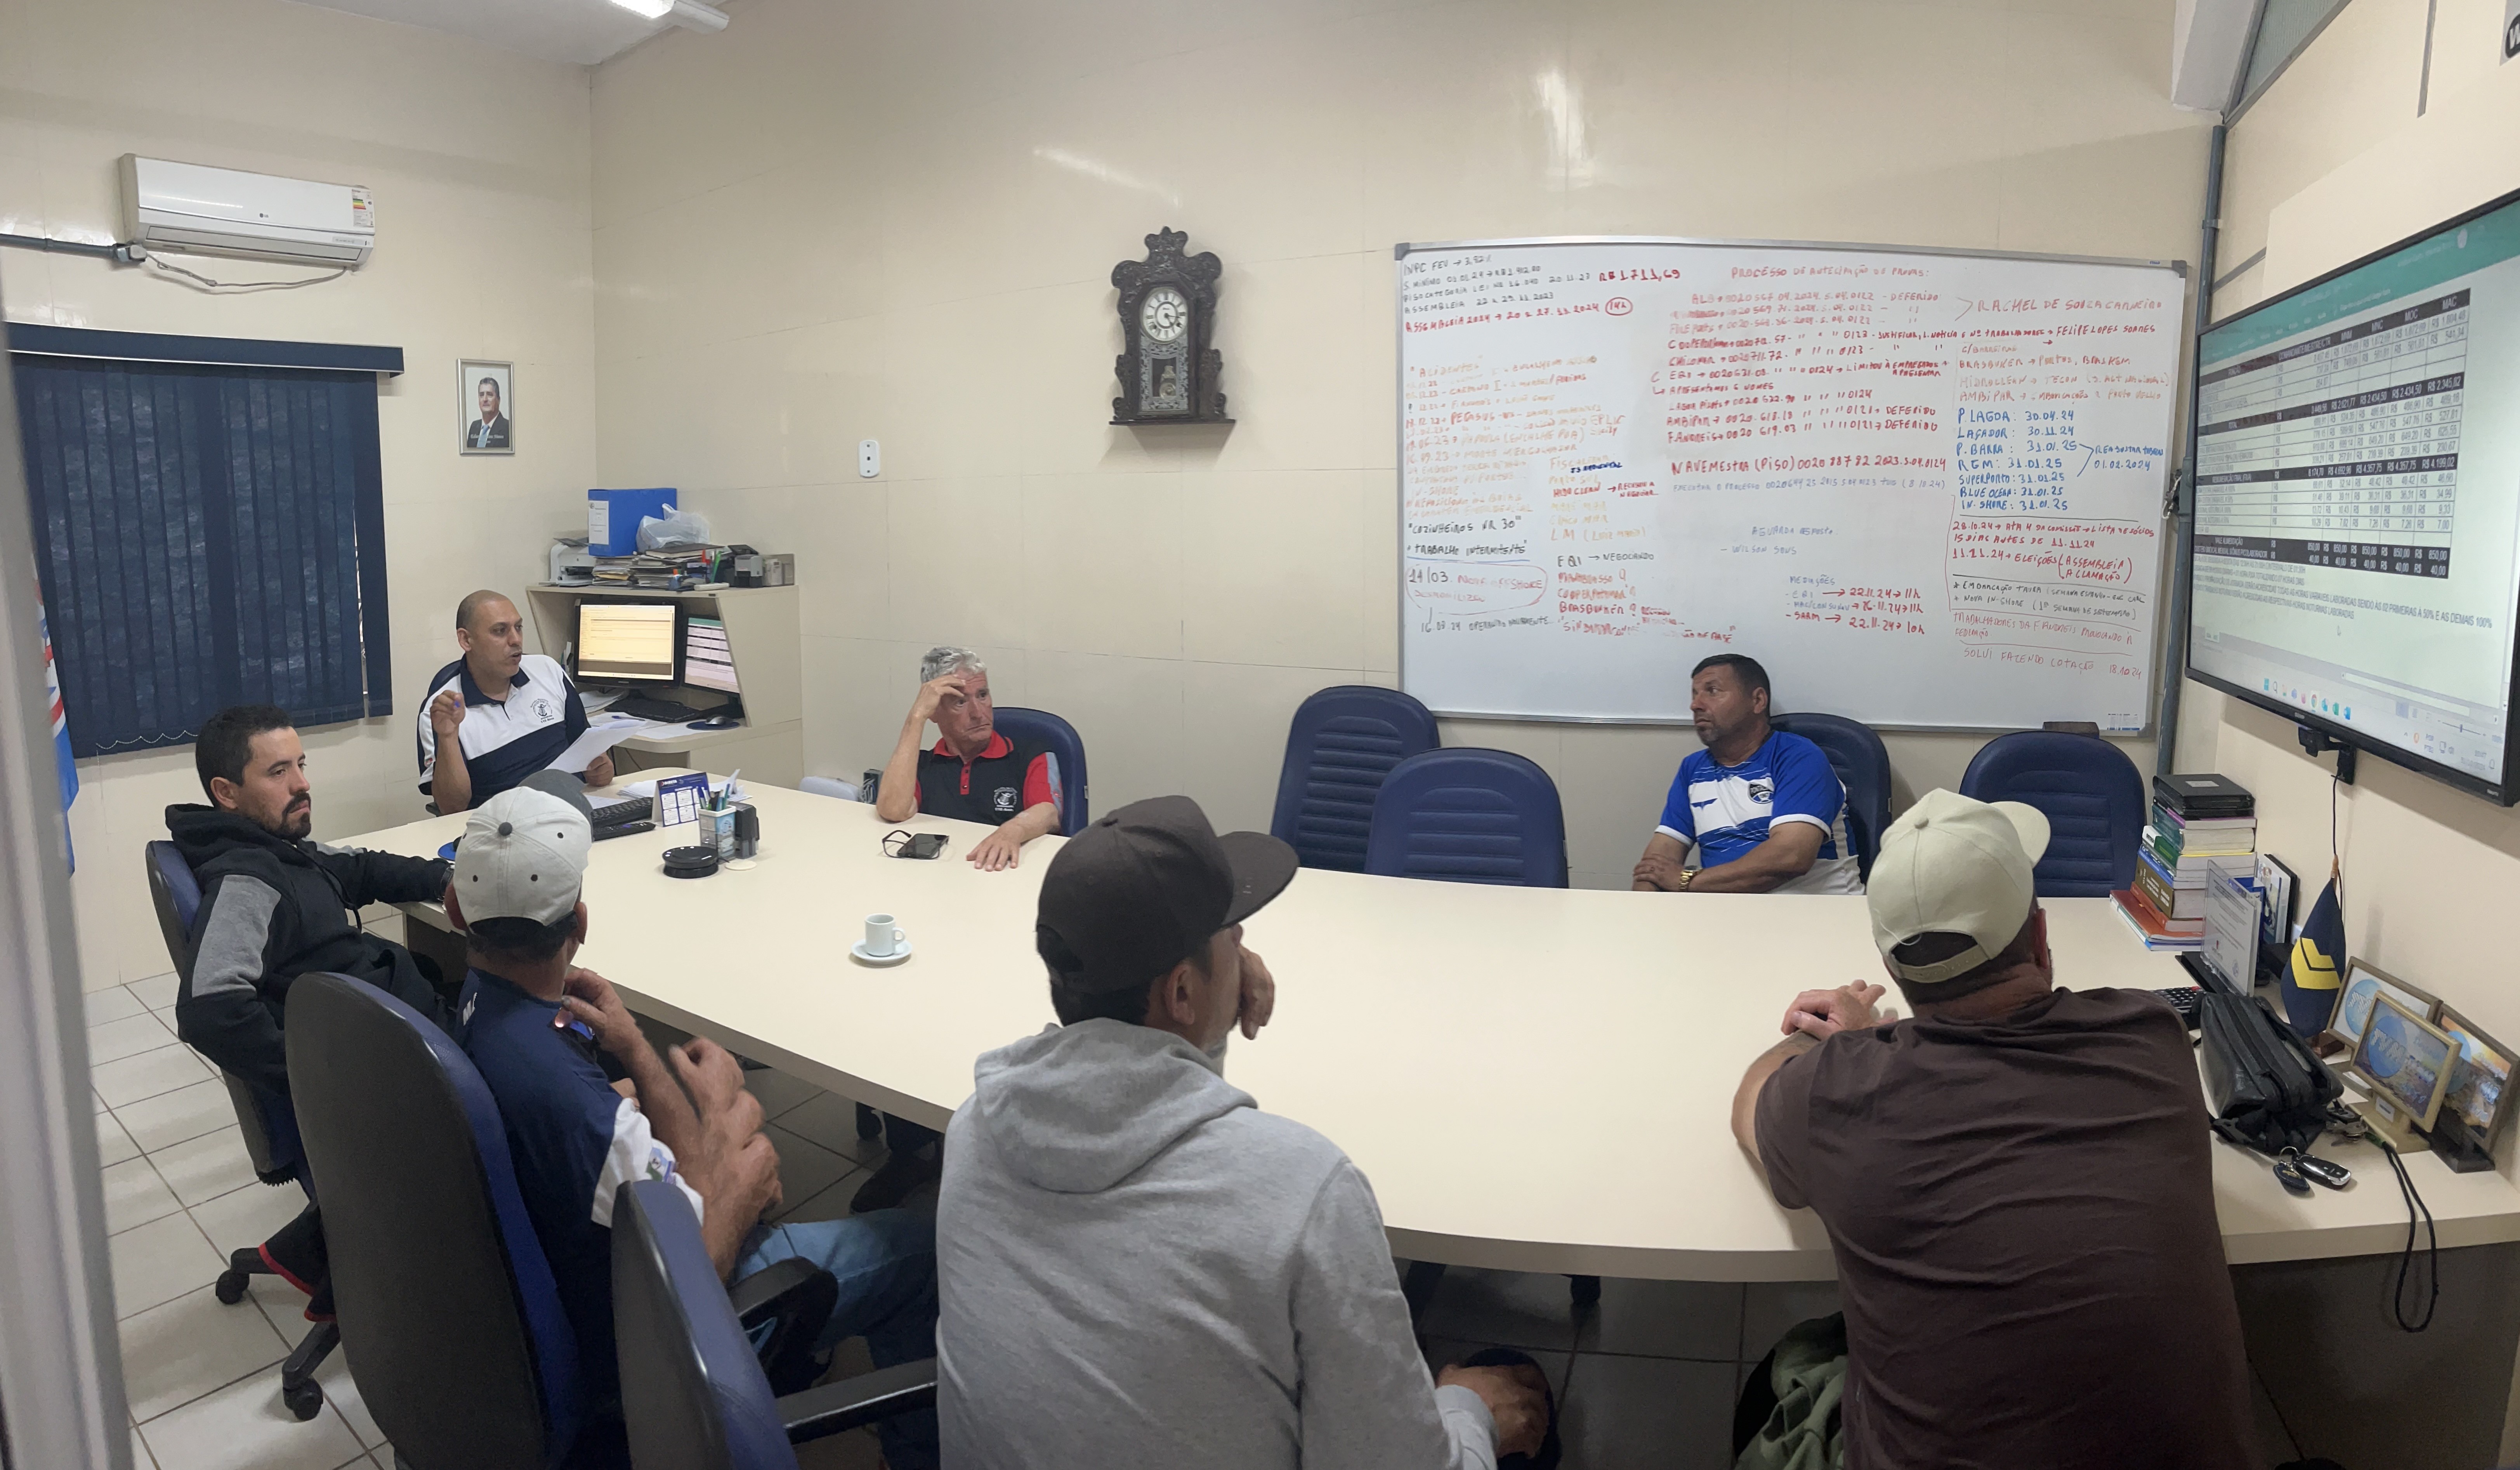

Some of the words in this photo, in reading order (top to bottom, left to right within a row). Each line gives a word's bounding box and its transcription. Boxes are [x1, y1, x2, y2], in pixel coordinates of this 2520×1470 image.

[1977, 297, 2038, 313] RACHEL
[2044, 298, 2060, 310] DE
[2442, 295, 2458, 310] MAC
[2025, 410, 2074, 421] 30.04.24
[1960, 487, 1985, 499] BLUE
